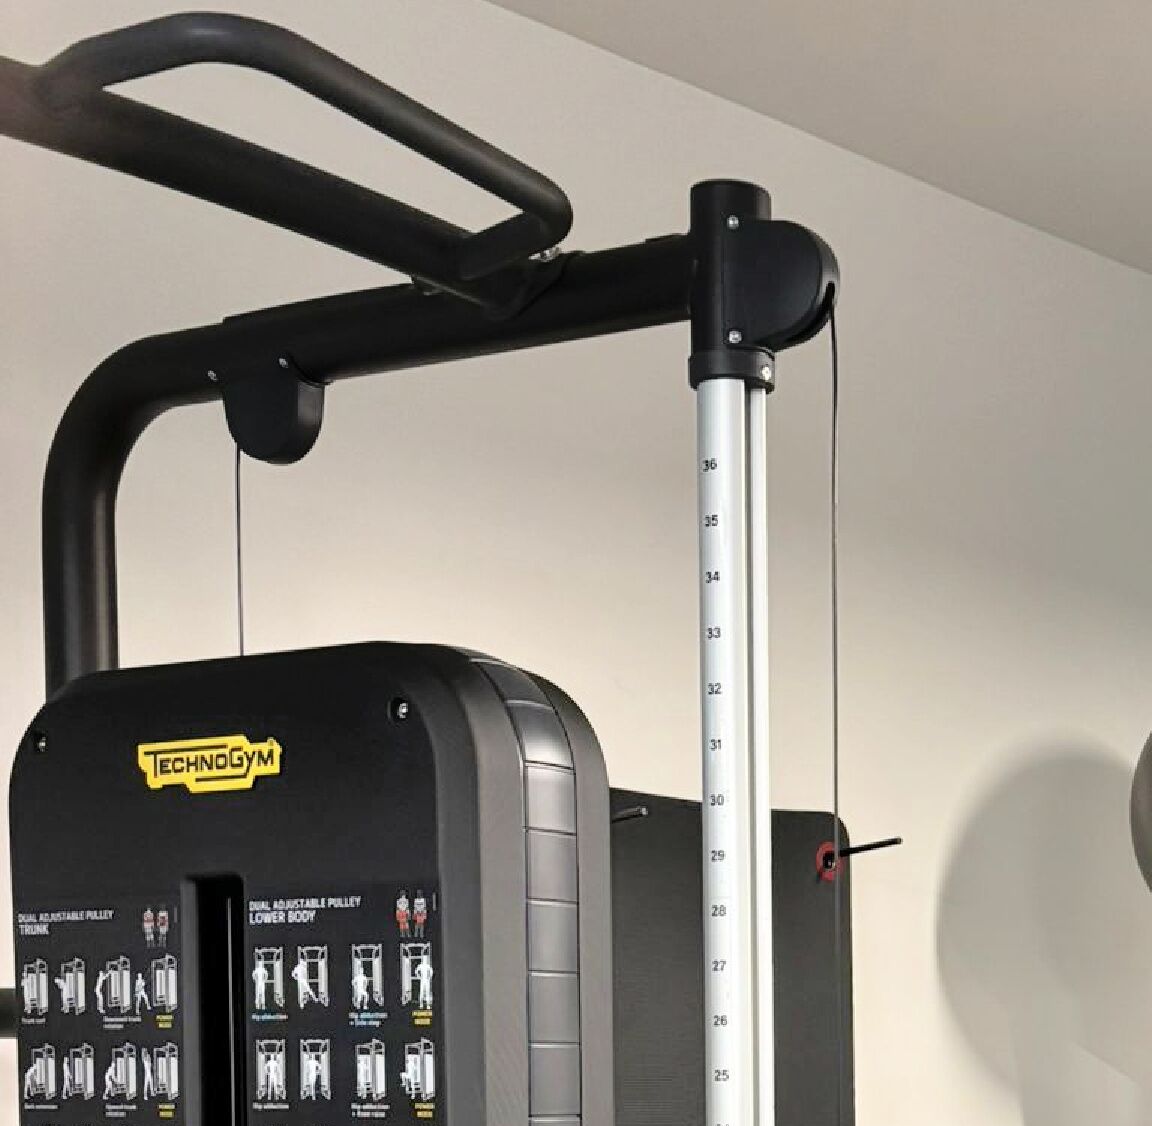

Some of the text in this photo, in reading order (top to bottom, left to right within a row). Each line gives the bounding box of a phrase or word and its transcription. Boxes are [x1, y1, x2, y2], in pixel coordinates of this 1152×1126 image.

[702, 457, 718, 473] 36
[704, 514, 719, 528] 35
[705, 570, 721, 584] 34
[707, 626, 722, 641] 33
[707, 682, 722, 696] 32
[710, 738, 722, 752] 31
[142, 741, 276, 783] TECHNOGYM
[710, 793, 725, 807] 30
[710, 849, 727, 863] 29
[249, 909, 317, 925] LOWER BODY
[711, 904, 727, 918] 28
[18, 923, 49, 935] TRUNK
[711, 960, 727, 972] 27
[713, 1014, 728, 1028] 26
[714, 1069, 730, 1082] 25
